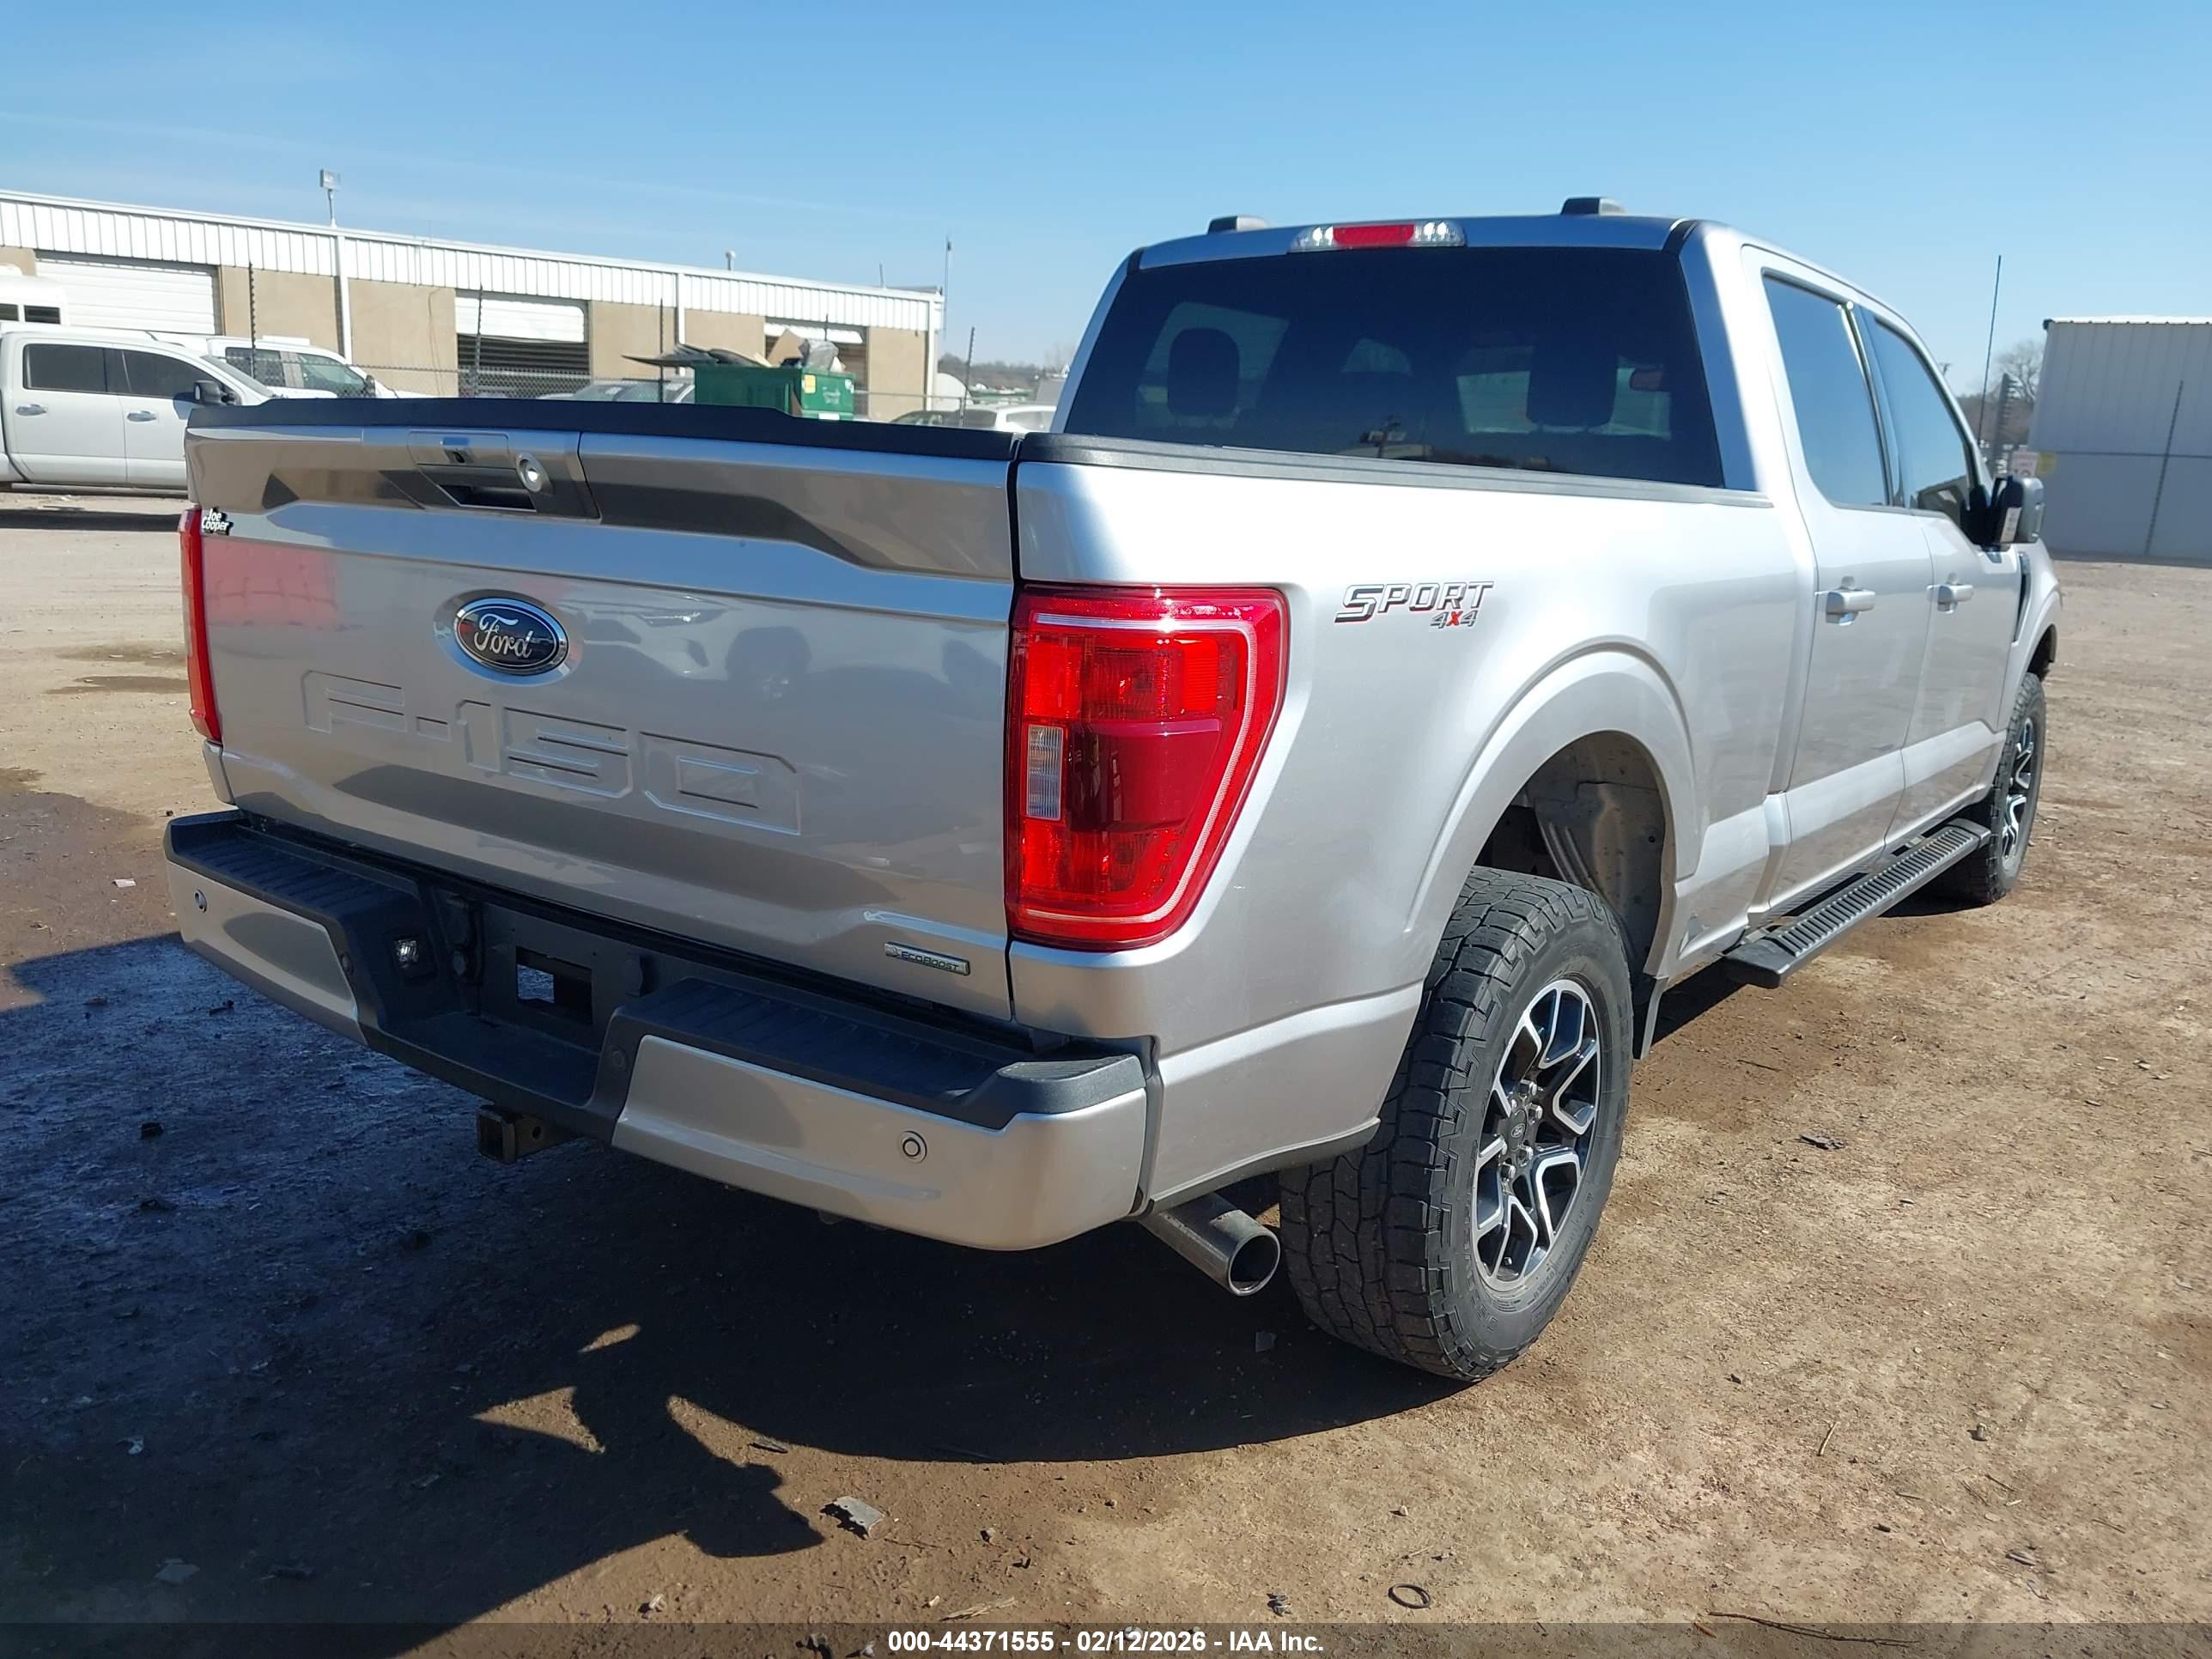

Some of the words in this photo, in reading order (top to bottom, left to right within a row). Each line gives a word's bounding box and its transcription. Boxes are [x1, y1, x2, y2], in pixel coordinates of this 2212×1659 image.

[201, 517, 229, 532] Cooper
[207, 508, 222, 522] Joe
[1334, 580, 1495, 623] SPORT
[473, 612, 533, 659] Ford
[301, 669, 803, 836] F-150
